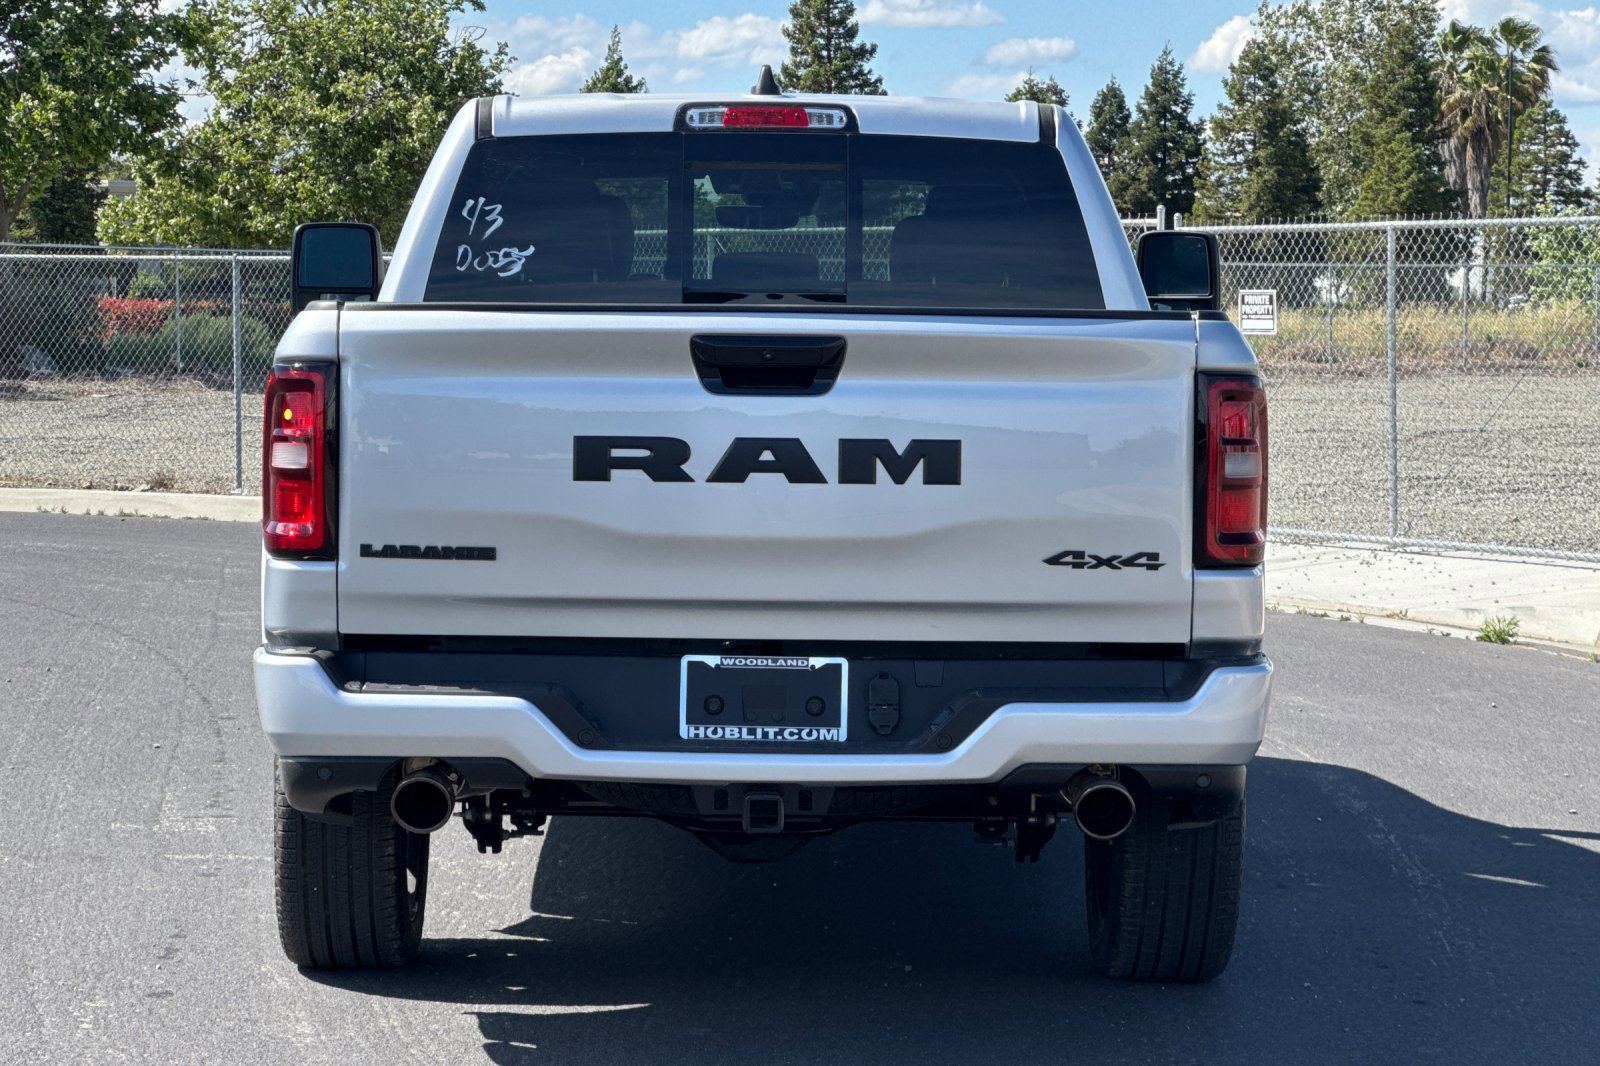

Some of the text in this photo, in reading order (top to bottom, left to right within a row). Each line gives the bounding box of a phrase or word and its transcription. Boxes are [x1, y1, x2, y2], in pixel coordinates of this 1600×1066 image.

[1244, 294, 1270, 305] PRIVATE
[1242, 304, 1273, 315] PROPERTY
[573, 435, 962, 486] RAM
[721, 657, 809, 667] WOODLAND
[688, 726, 839, 741] HOBLIT.COM
